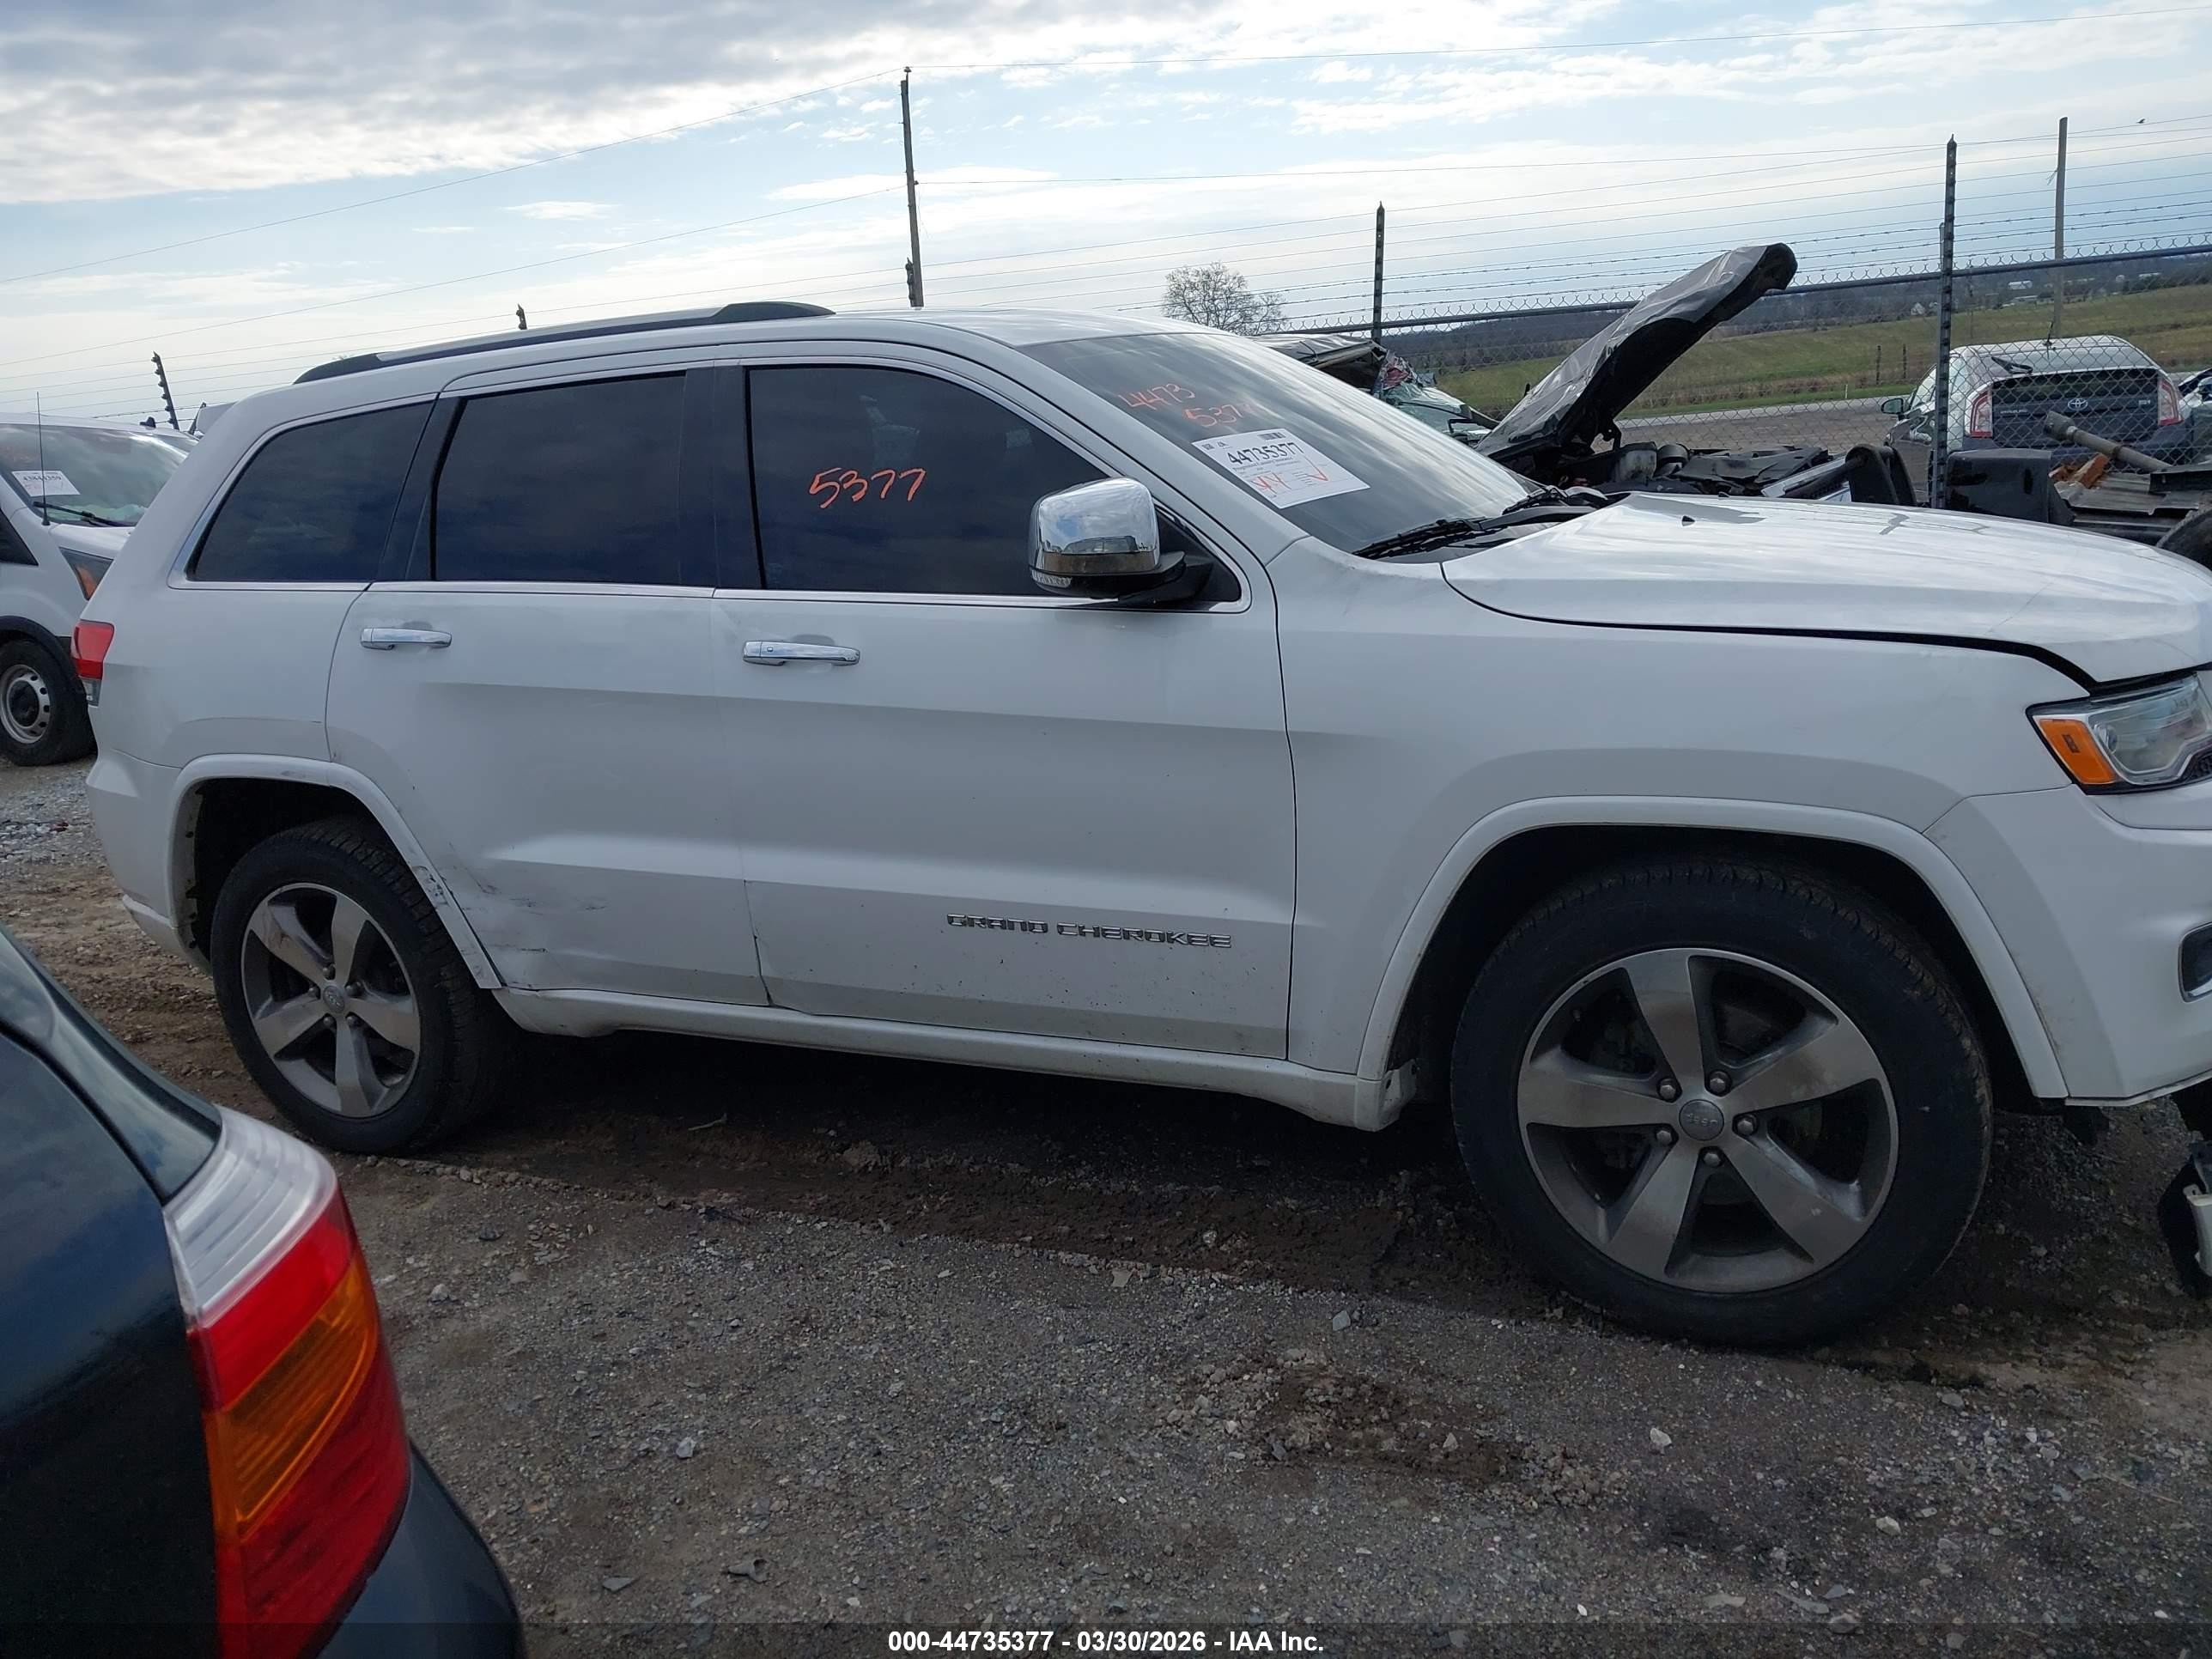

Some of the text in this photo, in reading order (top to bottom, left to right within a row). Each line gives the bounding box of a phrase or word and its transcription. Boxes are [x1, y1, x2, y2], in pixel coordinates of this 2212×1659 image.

[1118, 383, 1195, 410] 4473
[1226, 441, 1304, 465] 44735377
[809, 467, 926, 508] 5377
[946, 913, 1232, 948] GRAND CHEROKEE
